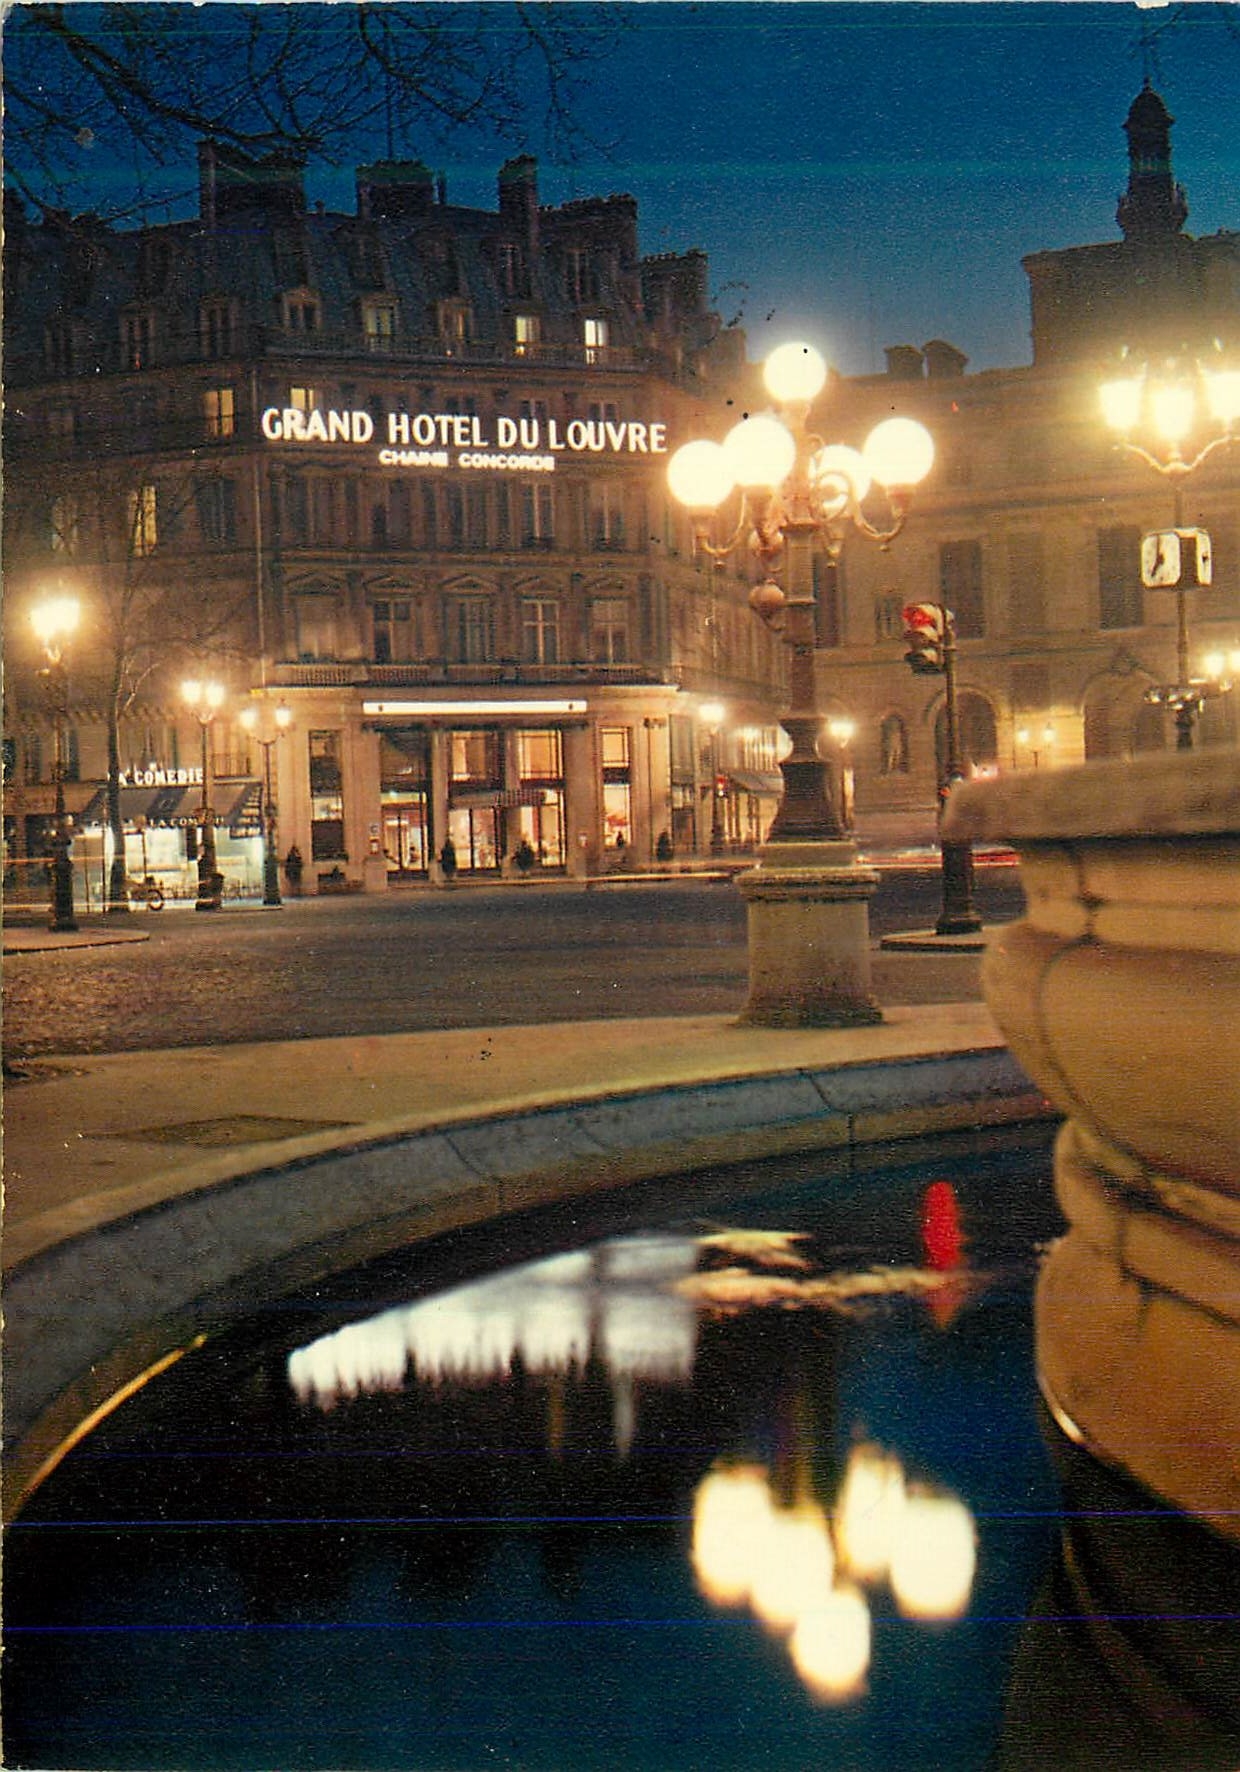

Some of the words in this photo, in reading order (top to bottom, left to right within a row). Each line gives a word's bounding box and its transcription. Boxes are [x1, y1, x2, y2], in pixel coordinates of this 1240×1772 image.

[261, 408, 374, 443] GRAND
[388, 413, 488, 447] HOTEL
[497, 418, 539, 448] DU
[549, 419, 667, 453] LOUVRE
[378, 449, 449, 467] CHAINE
[458, 452, 556, 472] CONCORDE
